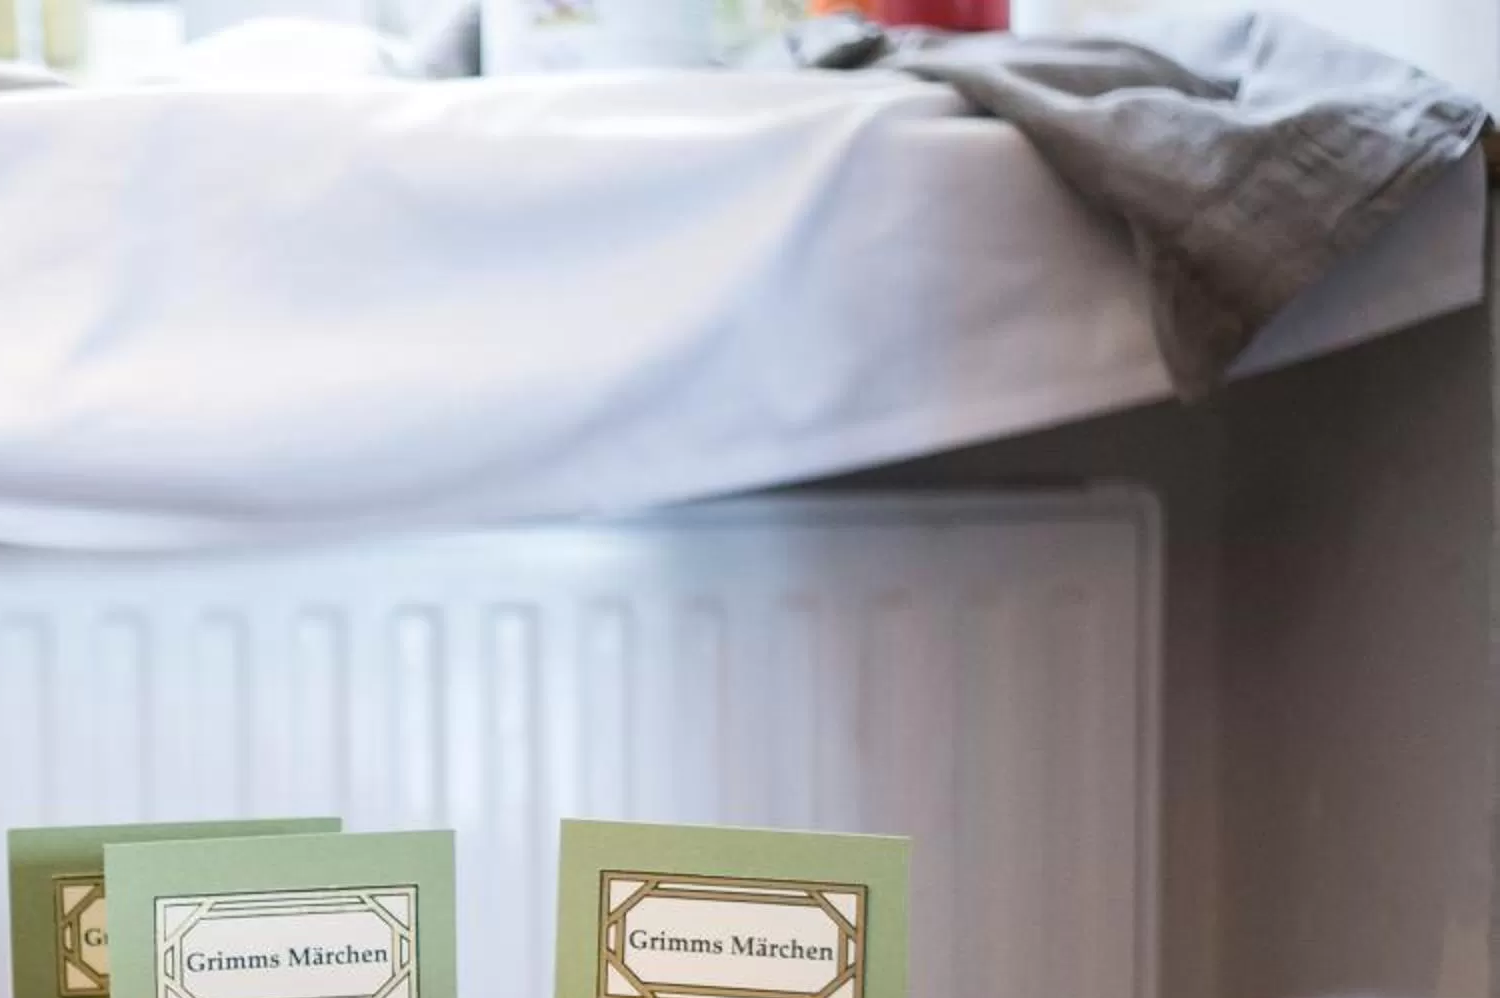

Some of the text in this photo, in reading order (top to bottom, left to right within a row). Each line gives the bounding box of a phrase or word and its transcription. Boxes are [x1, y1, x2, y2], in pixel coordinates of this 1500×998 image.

[186, 945, 389, 972] Grimms Märchen
[629, 929, 834, 961] Grimms Märchen
